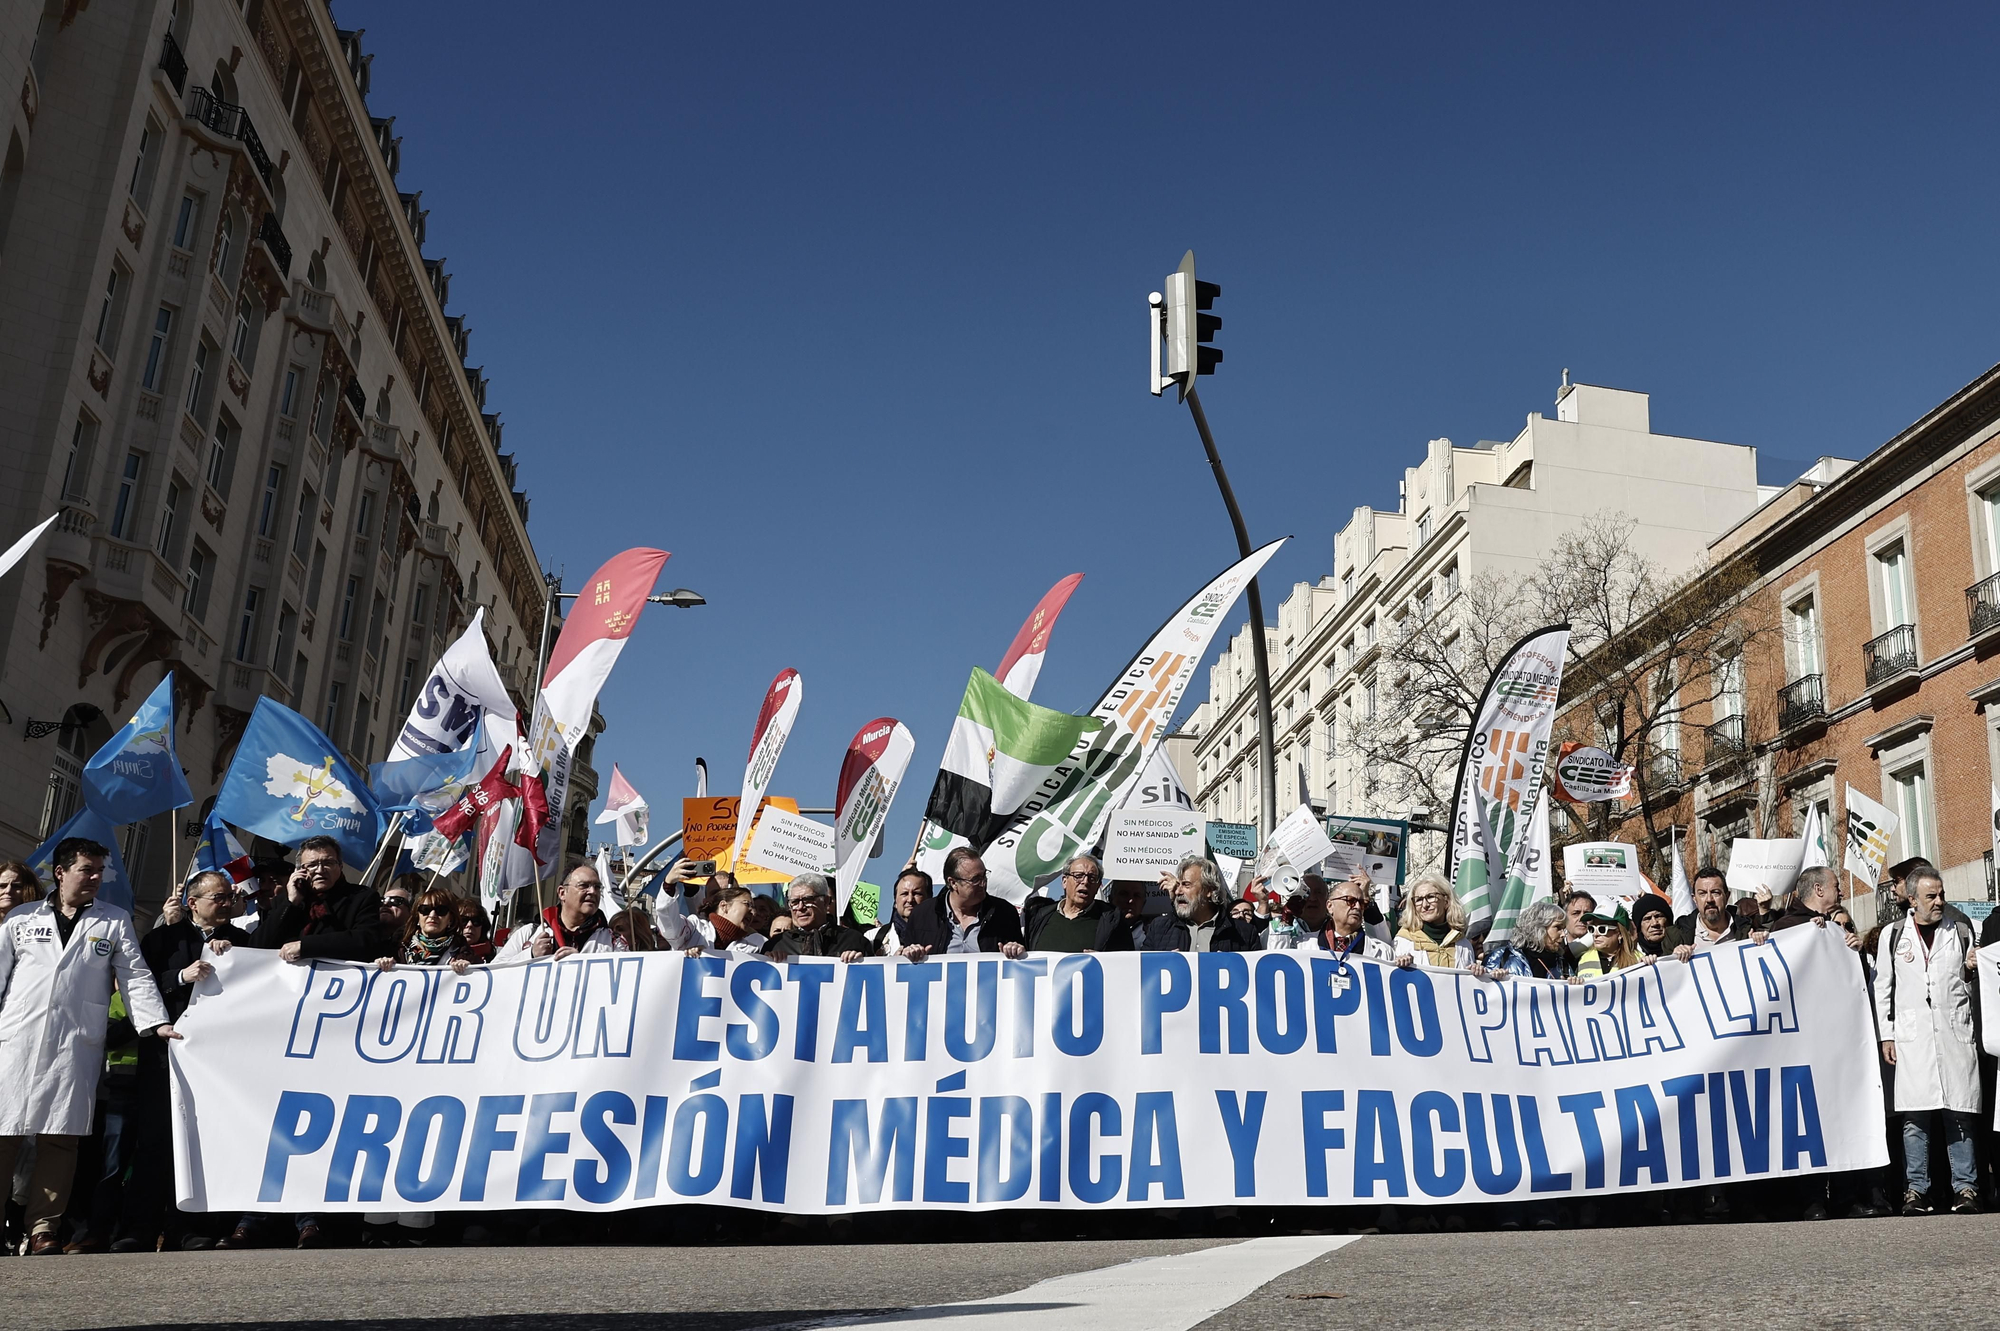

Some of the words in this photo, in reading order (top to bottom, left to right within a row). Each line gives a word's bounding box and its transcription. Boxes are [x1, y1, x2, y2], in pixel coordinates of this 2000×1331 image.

[1533, 672, 1560, 687] MÉDICO
[416, 674, 482, 745] SM
[862, 725, 891, 745] Murcia
[556, 725, 582, 770] Murcia
[1567, 755, 1605, 768] SINDICATO
[553, 768, 565, 788] de
[1520, 739, 1549, 817] Mancha
[883, 780, 898, 805] Murcia
[1603, 785, 1630, 795] Mancha
[544, 789, 563, 831] Región
[840, 798, 862, 841] Sindicato
[858, 766, 876, 799] Médico
[880, 803, 888, 814] de
[706, 822, 738, 832] PODREM
[780, 818, 793, 827] SIN
[793, 822, 826, 838] MÉDICOS
[869, 812, 883, 837] Región
[1138, 818, 1174, 828] MÉDICOS
[770, 825, 782, 834] NO
[782, 829, 797, 839] HAY
[797, 834, 828, 850] SANIDAD
[1129, 830, 1146, 838] HAY
[1145, 830, 1180, 839] SANIDAD
[772, 841, 785, 850] SIN
[785, 845, 818, 862] MÉDICOS
[1137, 845, 1173, 855] MÉDICOS
[1223, 846, 1255, 857] Centro
[762, 848, 774, 857] NO
[774, 852, 789, 862] HAY
[789, 857, 821, 873] SANIDAD
[1129, 857, 1145, 865] HAY
[1145, 857, 1179, 866] SANIDAD
[1772, 862, 1797, 871] MÉDICOS
[25, 926, 53, 938] SME
[284, 958, 494, 1065] POR
[512, 957, 645, 1063] UN
[672, 954, 1105, 1064] ESTATUTO
[1139, 950, 1444, 1058] PROPIO
[1455, 963, 1686, 1067] PARA
[1688, 937, 1800, 1041] LA
[256, 1066, 795, 1205] PROFESIÓN
[825, 1068, 1186, 1207] MÉDICA
[1214, 1089, 1268, 1199] Y
[1300, 1064, 1828, 1199] FACULTATIVA
